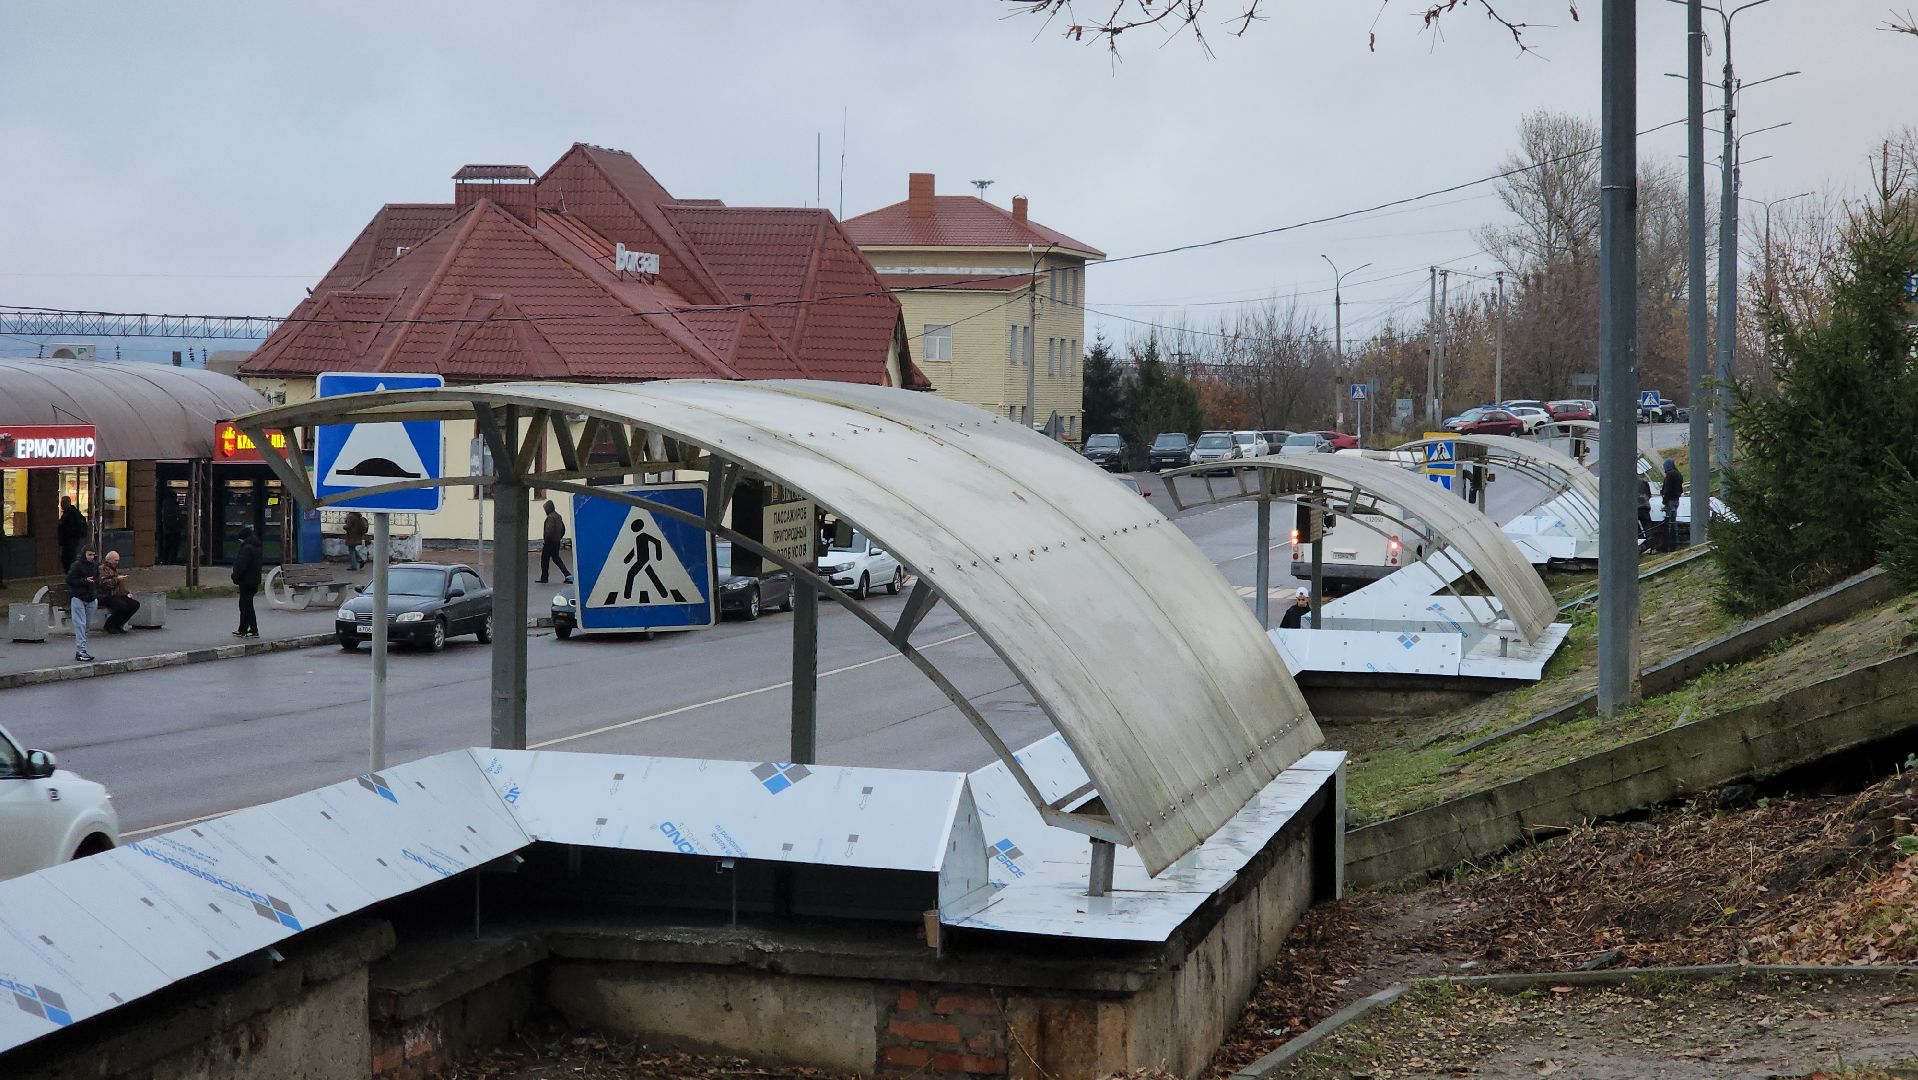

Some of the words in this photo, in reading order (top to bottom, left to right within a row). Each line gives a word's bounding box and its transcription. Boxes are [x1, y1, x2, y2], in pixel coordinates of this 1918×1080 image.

[17, 437, 95, 459] ЕРМОЛИНО
[659, 821, 697, 855] OND
[128, 843, 270, 907] GROSSBON
[996, 854, 1026, 879] GROS
